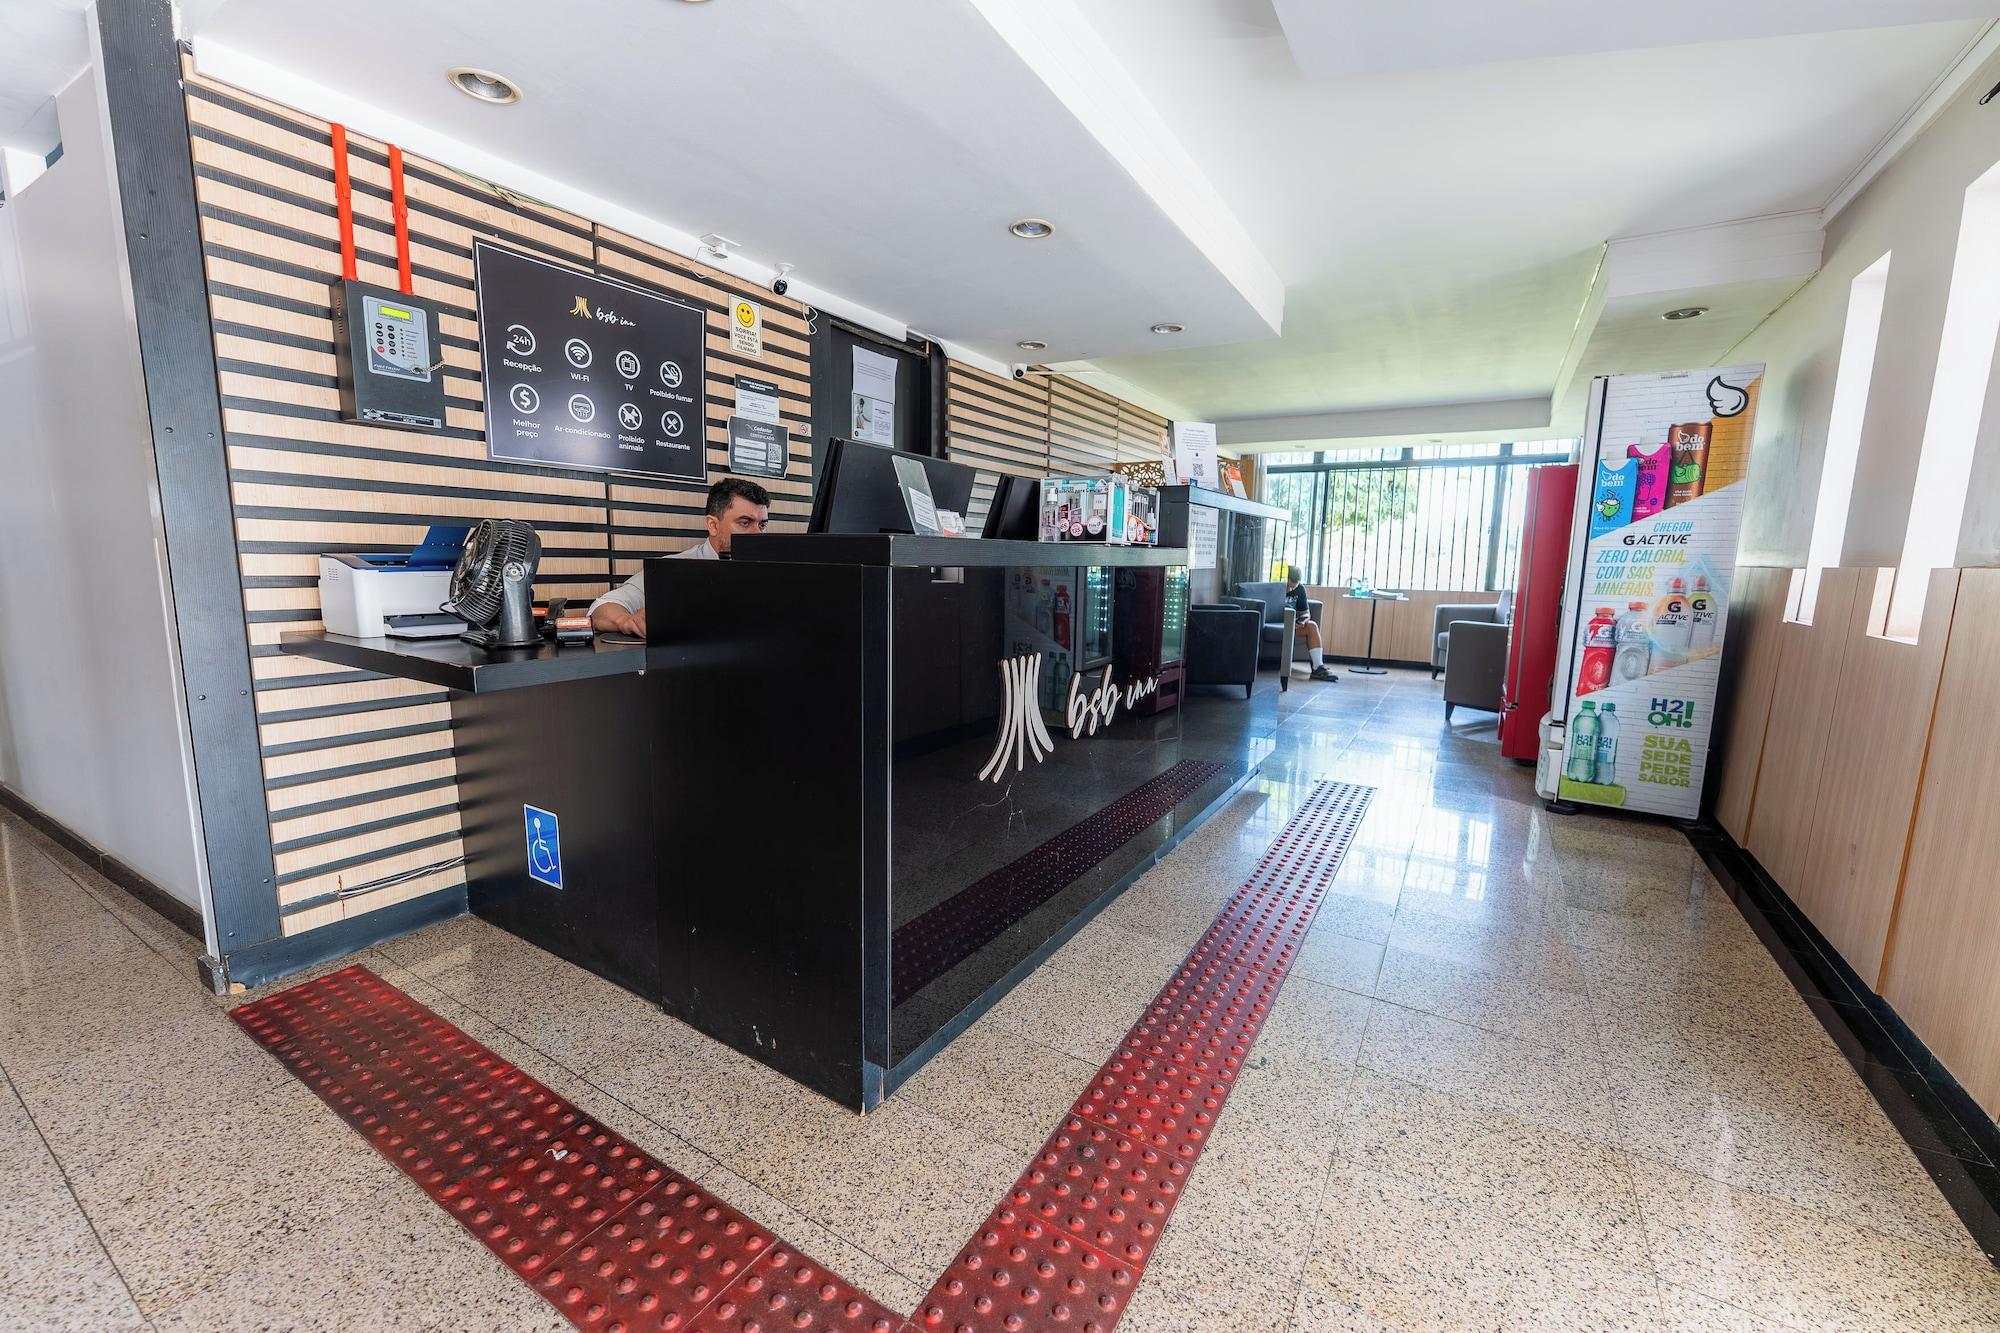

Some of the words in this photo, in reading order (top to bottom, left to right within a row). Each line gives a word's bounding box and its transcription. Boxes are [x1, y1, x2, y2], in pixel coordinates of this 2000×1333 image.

[513, 334, 531, 346] 24h
[503, 358, 542, 373] Recepção
[624, 383, 634, 391] TV
[649, 388, 675, 400] Proibido
[675, 392, 694, 403] fumar
[513, 419, 541, 429] Melhor
[516, 429, 539, 438] preço
[554, 425, 611, 439] Ar-condicionado
[618, 434, 645, 444] Proibido
[1689, 434, 1705, 443] do
[618, 443, 644, 452] animais
[655, 439, 691, 451] Restaurante
[1676, 442, 1704, 451] bem
[1611, 472, 1625, 481] do
[1601, 479, 1624, 487] bem
[1653, 521, 1694, 533] CHEGOU
[1636, 534, 1691, 545] ACTIVE
[1596, 549, 1629, 563] ZERO
[1632, 549, 1686, 565] CALORIA,
[1596, 566, 1625, 580] COM
[1627, 565, 1655, 580] SAIS
[1594, 581, 1653, 597] MINERAIS.
[1667, 601, 1682, 613] G
[1692, 599, 1707, 611] G
[1658, 613, 1689, 621] ACTIVE
[1065, 663, 1122, 740] bsb
[1126, 674, 1159, 710] inn
[1651, 698, 1685, 714] H2
[1643, 734, 1692, 753] SUA
[1641, 748, 1692, 765] SEDE
[1640, 761, 1691, 778] PEDE
[1638, 773, 1691, 788] SABOR
